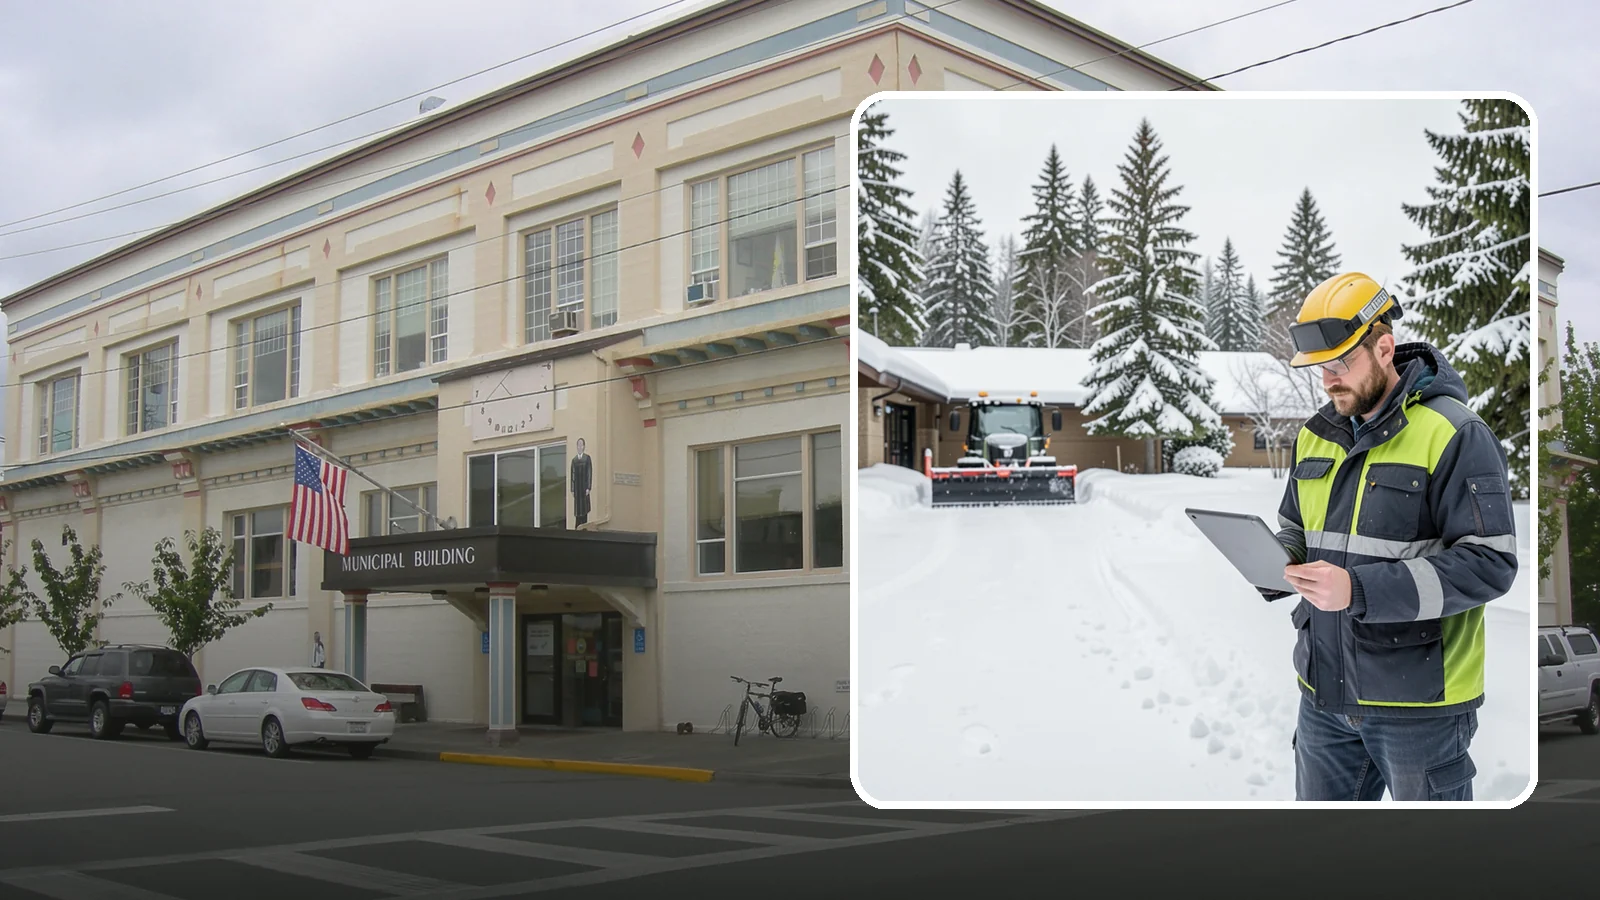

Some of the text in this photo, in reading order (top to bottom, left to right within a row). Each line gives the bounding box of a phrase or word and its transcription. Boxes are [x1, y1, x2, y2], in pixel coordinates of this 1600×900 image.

[536, 402, 540, 410] 4
[481, 407, 484, 415] 8
[494, 424, 500, 432] 10
[342, 546, 475, 572] MUNICIPAL BUILDING
